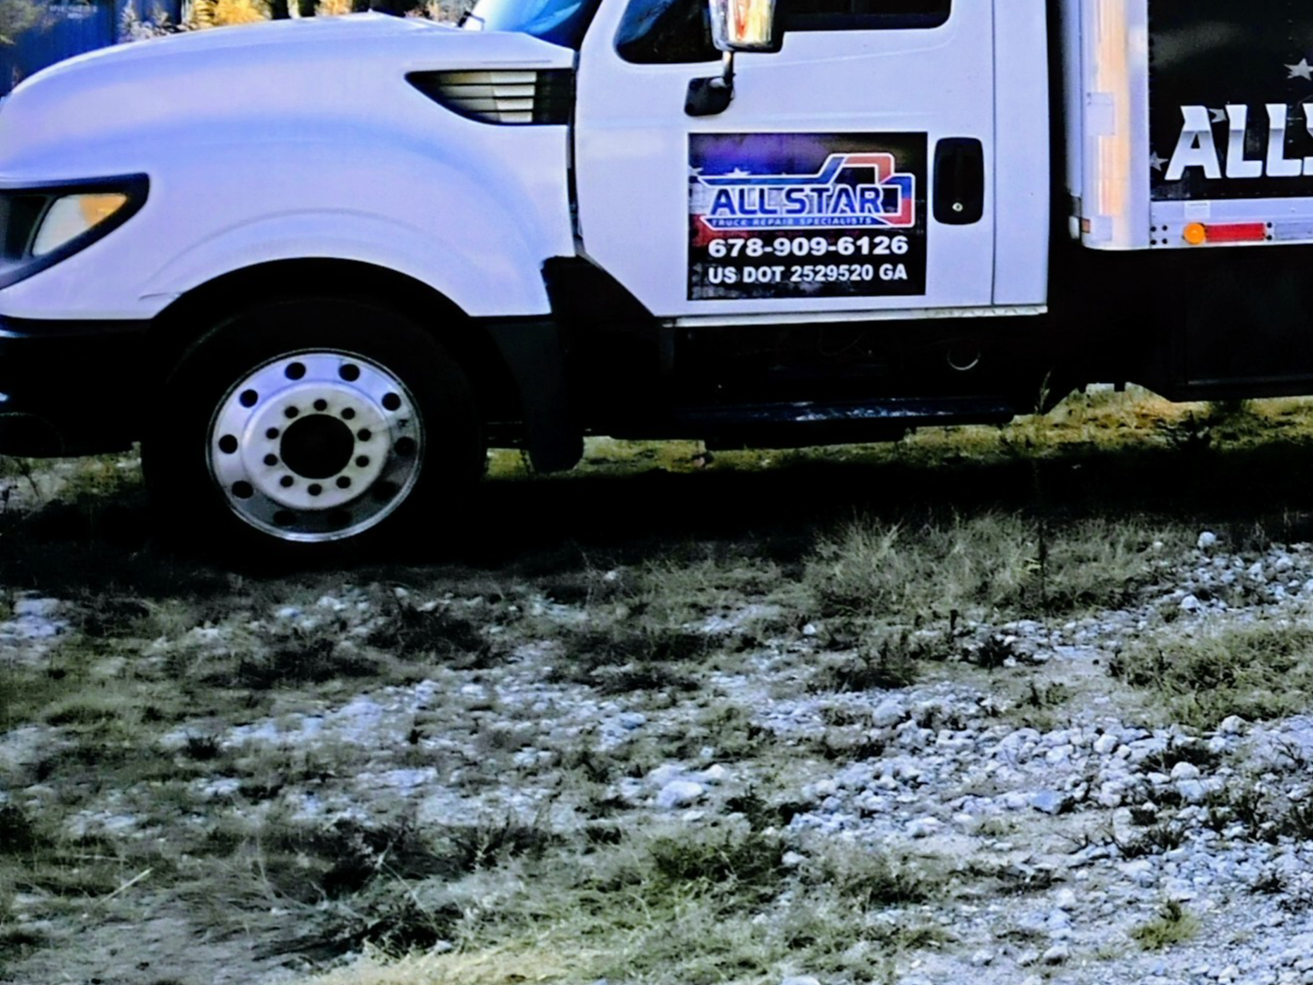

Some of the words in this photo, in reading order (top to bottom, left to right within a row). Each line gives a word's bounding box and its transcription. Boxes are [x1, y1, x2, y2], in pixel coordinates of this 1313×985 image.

[711, 219, 747, 227] TRUCK
[752, 218, 794, 226] REPAIR
[800, 217, 872, 225] SPECIALISTS
[708, 236, 909, 258] 678-909-6126
[708, 267, 737, 284] US
[743, 266, 785, 284] DOT
[790, 264, 874, 282] 2529520
[879, 263, 908, 281] GA
